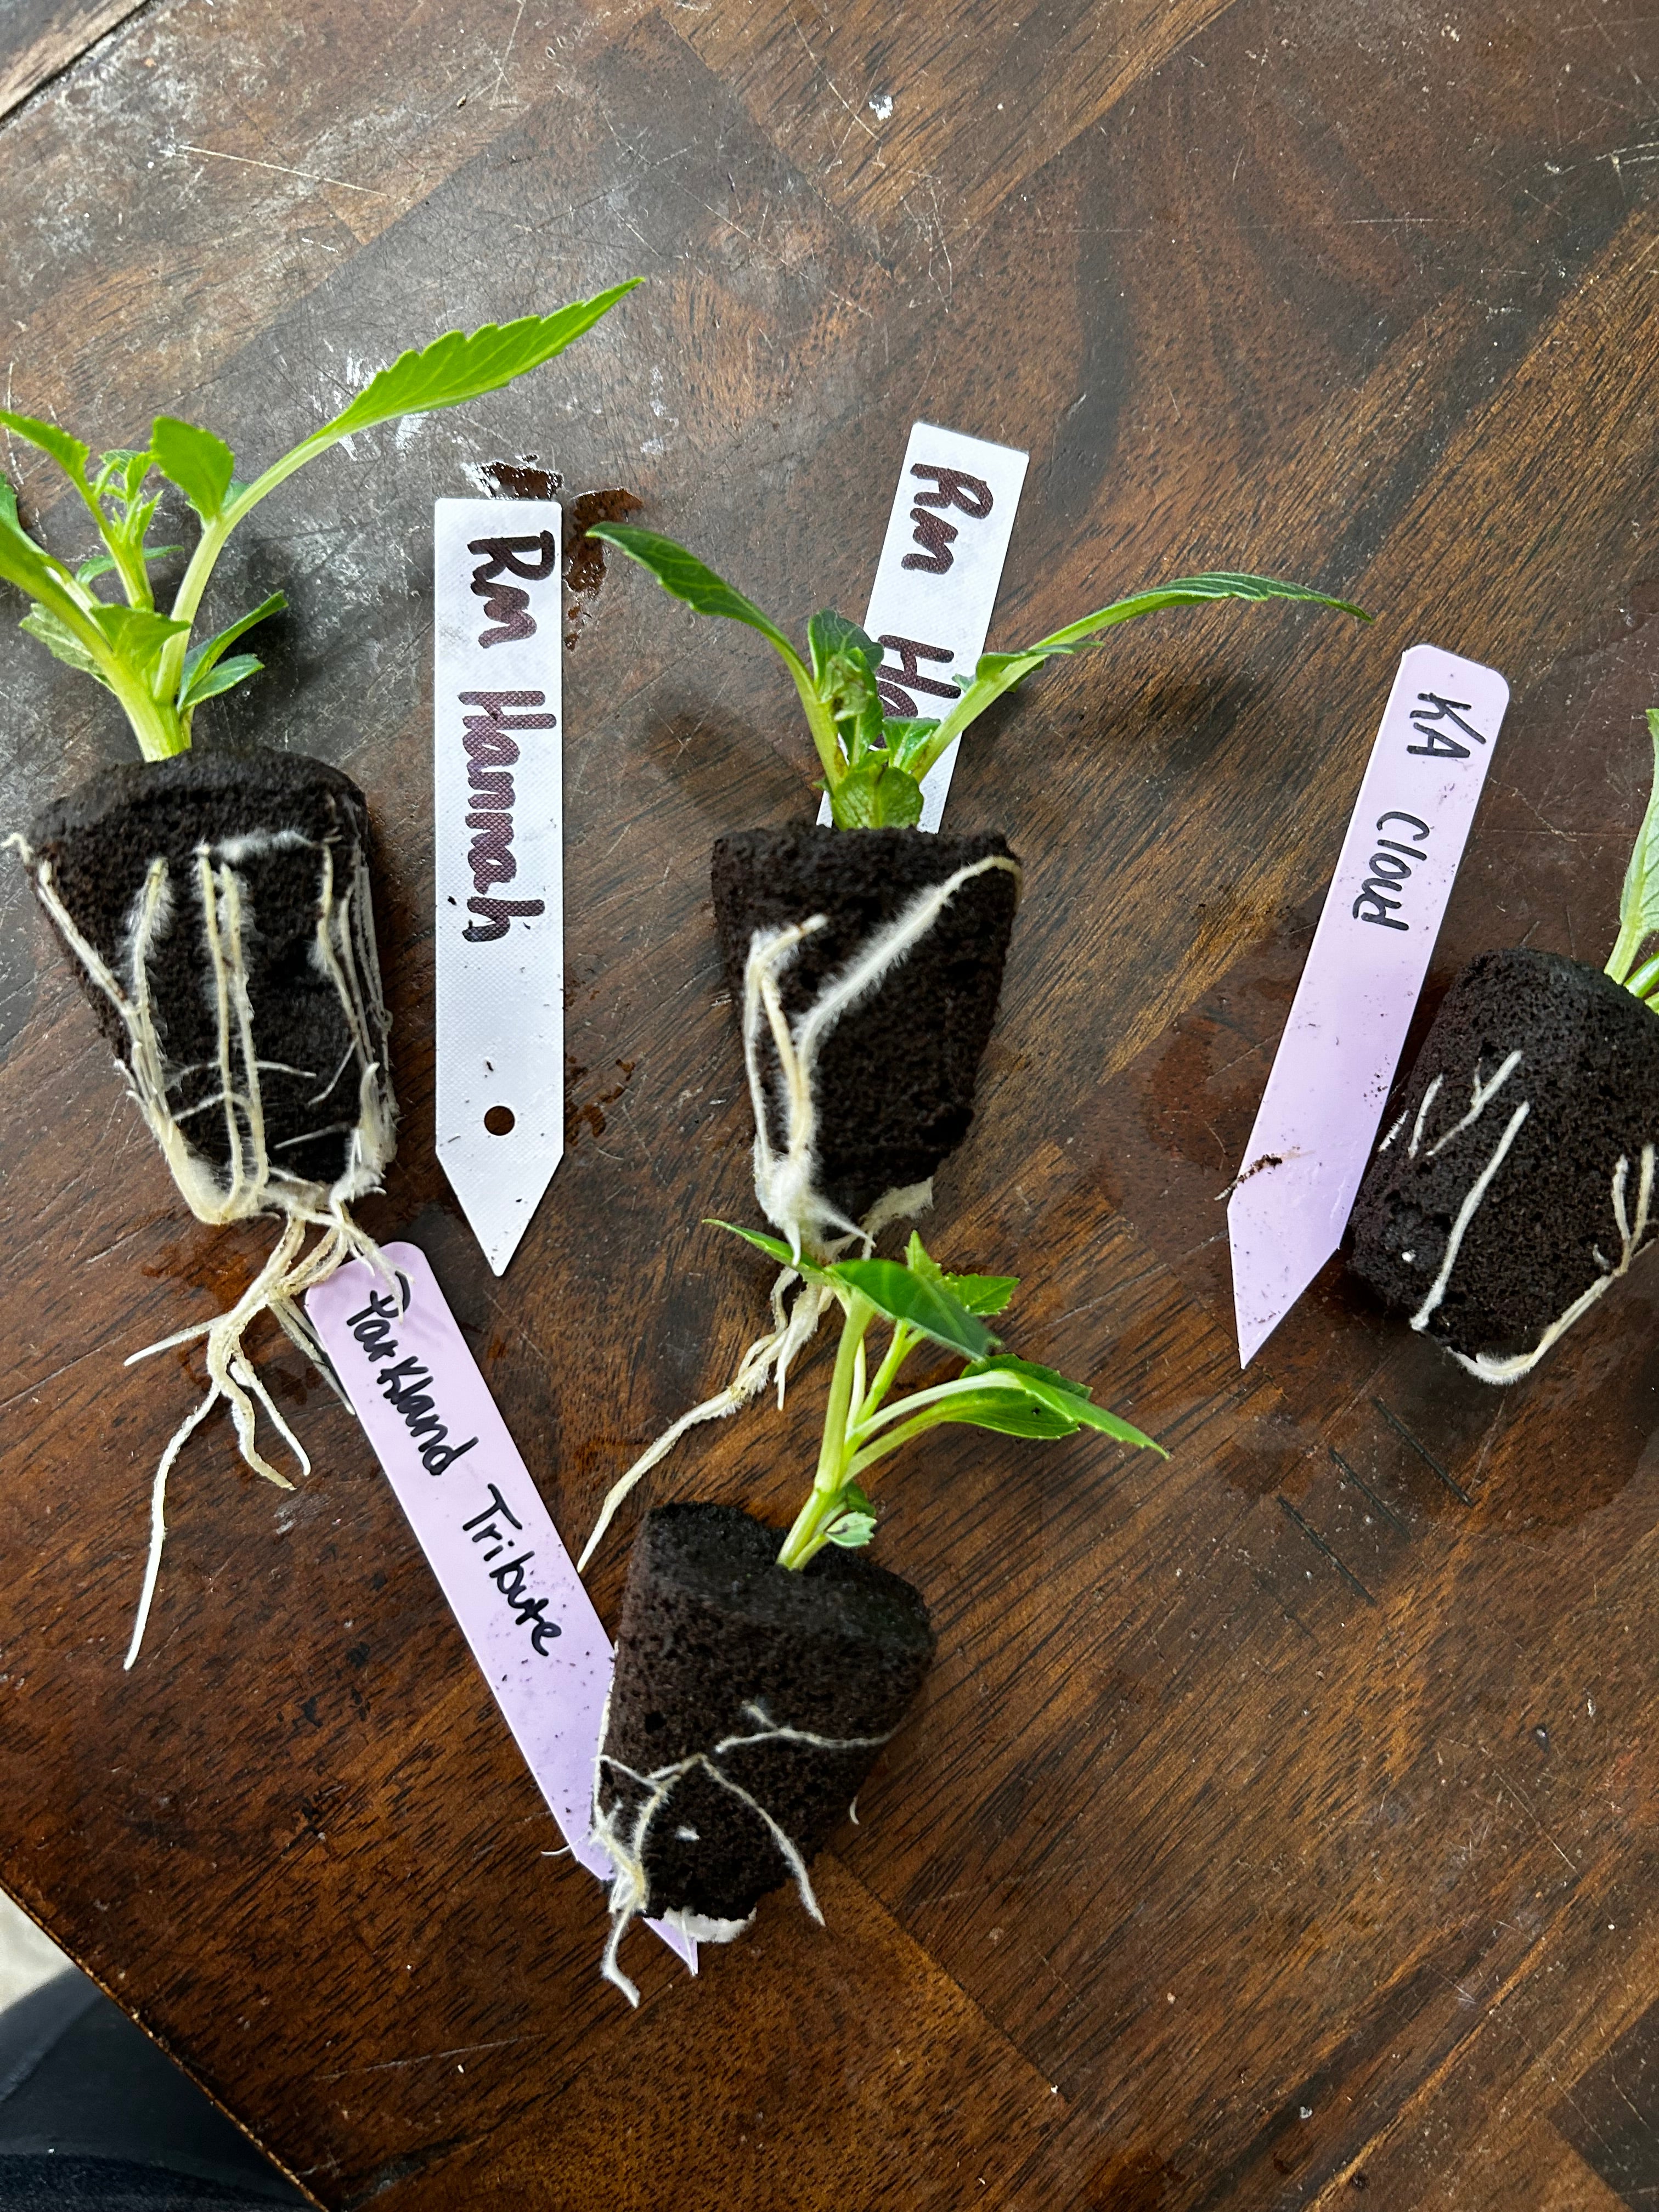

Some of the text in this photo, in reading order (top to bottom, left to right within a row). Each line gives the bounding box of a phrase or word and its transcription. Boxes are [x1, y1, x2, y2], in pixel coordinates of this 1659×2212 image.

[457, 690, 557, 943] Hannah
[1352, 692, 1487, 931] KA Cloud
[462, 1483, 562, 1657] Tribute
